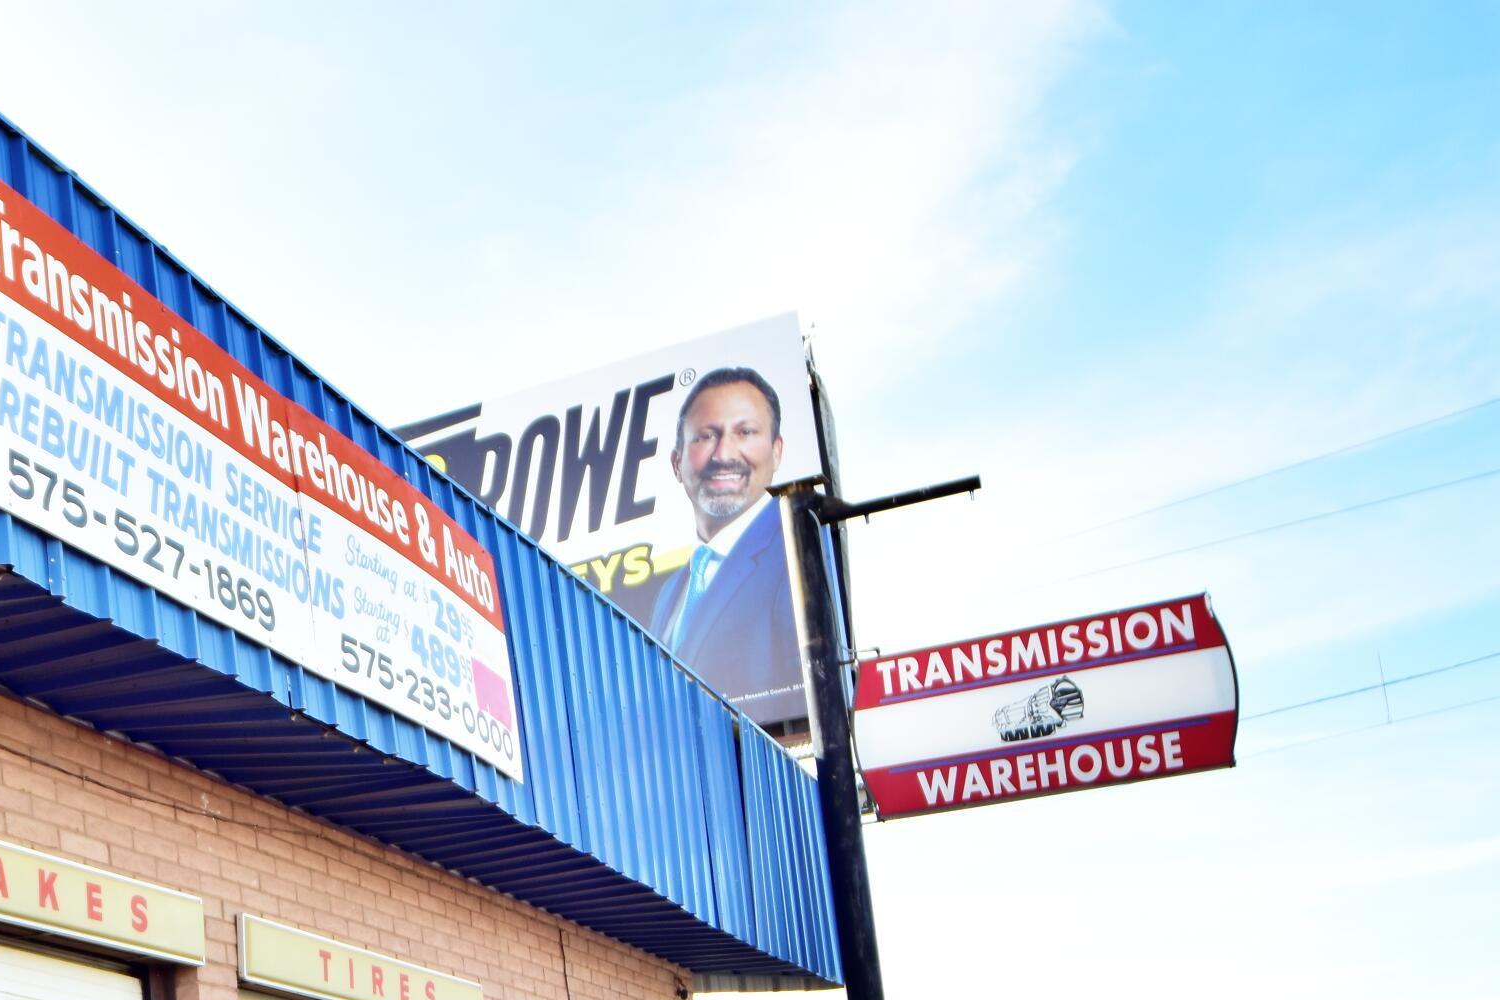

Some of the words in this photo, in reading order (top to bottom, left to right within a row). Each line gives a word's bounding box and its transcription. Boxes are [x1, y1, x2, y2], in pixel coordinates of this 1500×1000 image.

[224, 462, 322, 554] SERVICE
[231, 372, 410, 546] Warehouse
[414, 502, 439, 569] &
[442, 524, 495, 613] Auto
[8, 447, 276, 633] 575-527-1869
[146, 466, 345, 620] TRANSMISSIONS
[345, 533, 398, 595] Starting
[353, 585, 401, 636] Starting
[875, 603, 1196, 697] TRANSMISSION
[340, 632, 514, 761] 575-233-0000
[916, 730, 1184, 806] WAREHOUSE
